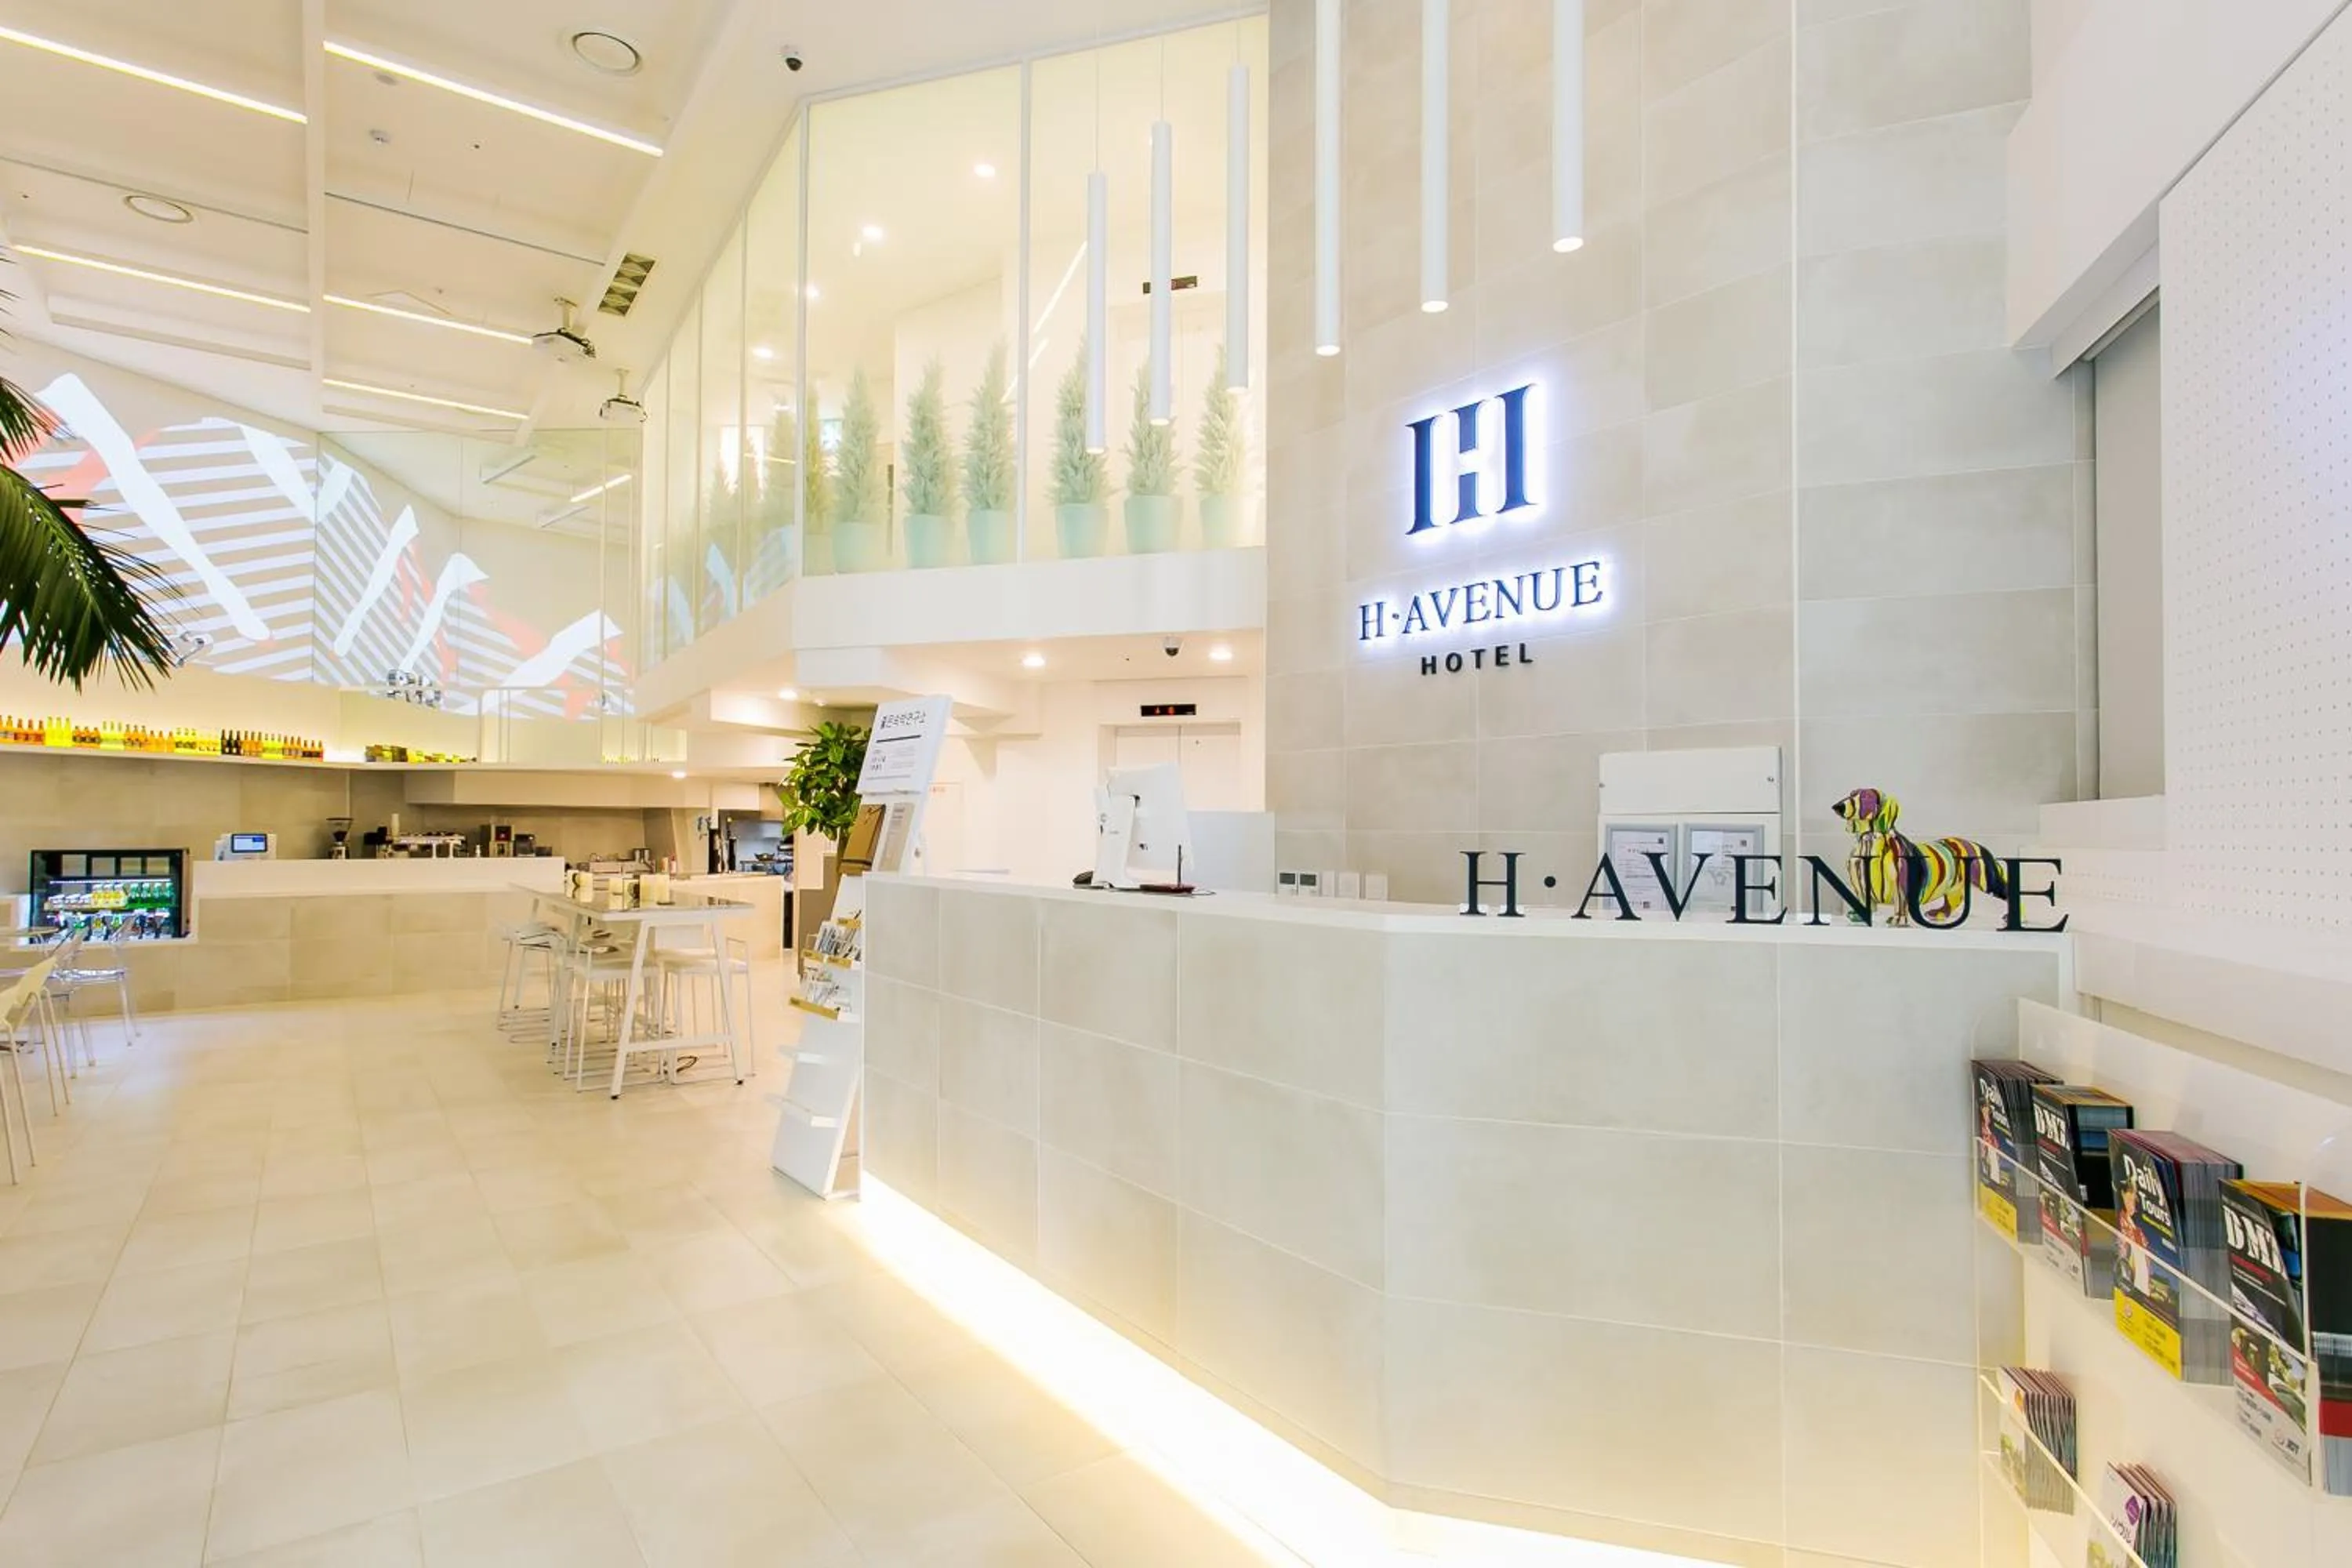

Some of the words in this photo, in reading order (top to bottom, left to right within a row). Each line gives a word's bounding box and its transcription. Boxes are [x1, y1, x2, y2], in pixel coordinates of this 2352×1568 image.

[1421, 643, 1534, 676] HOTEL
[2122, 1153, 2165, 1207] Daily
[2138, 1190, 2171, 1227] Tours
